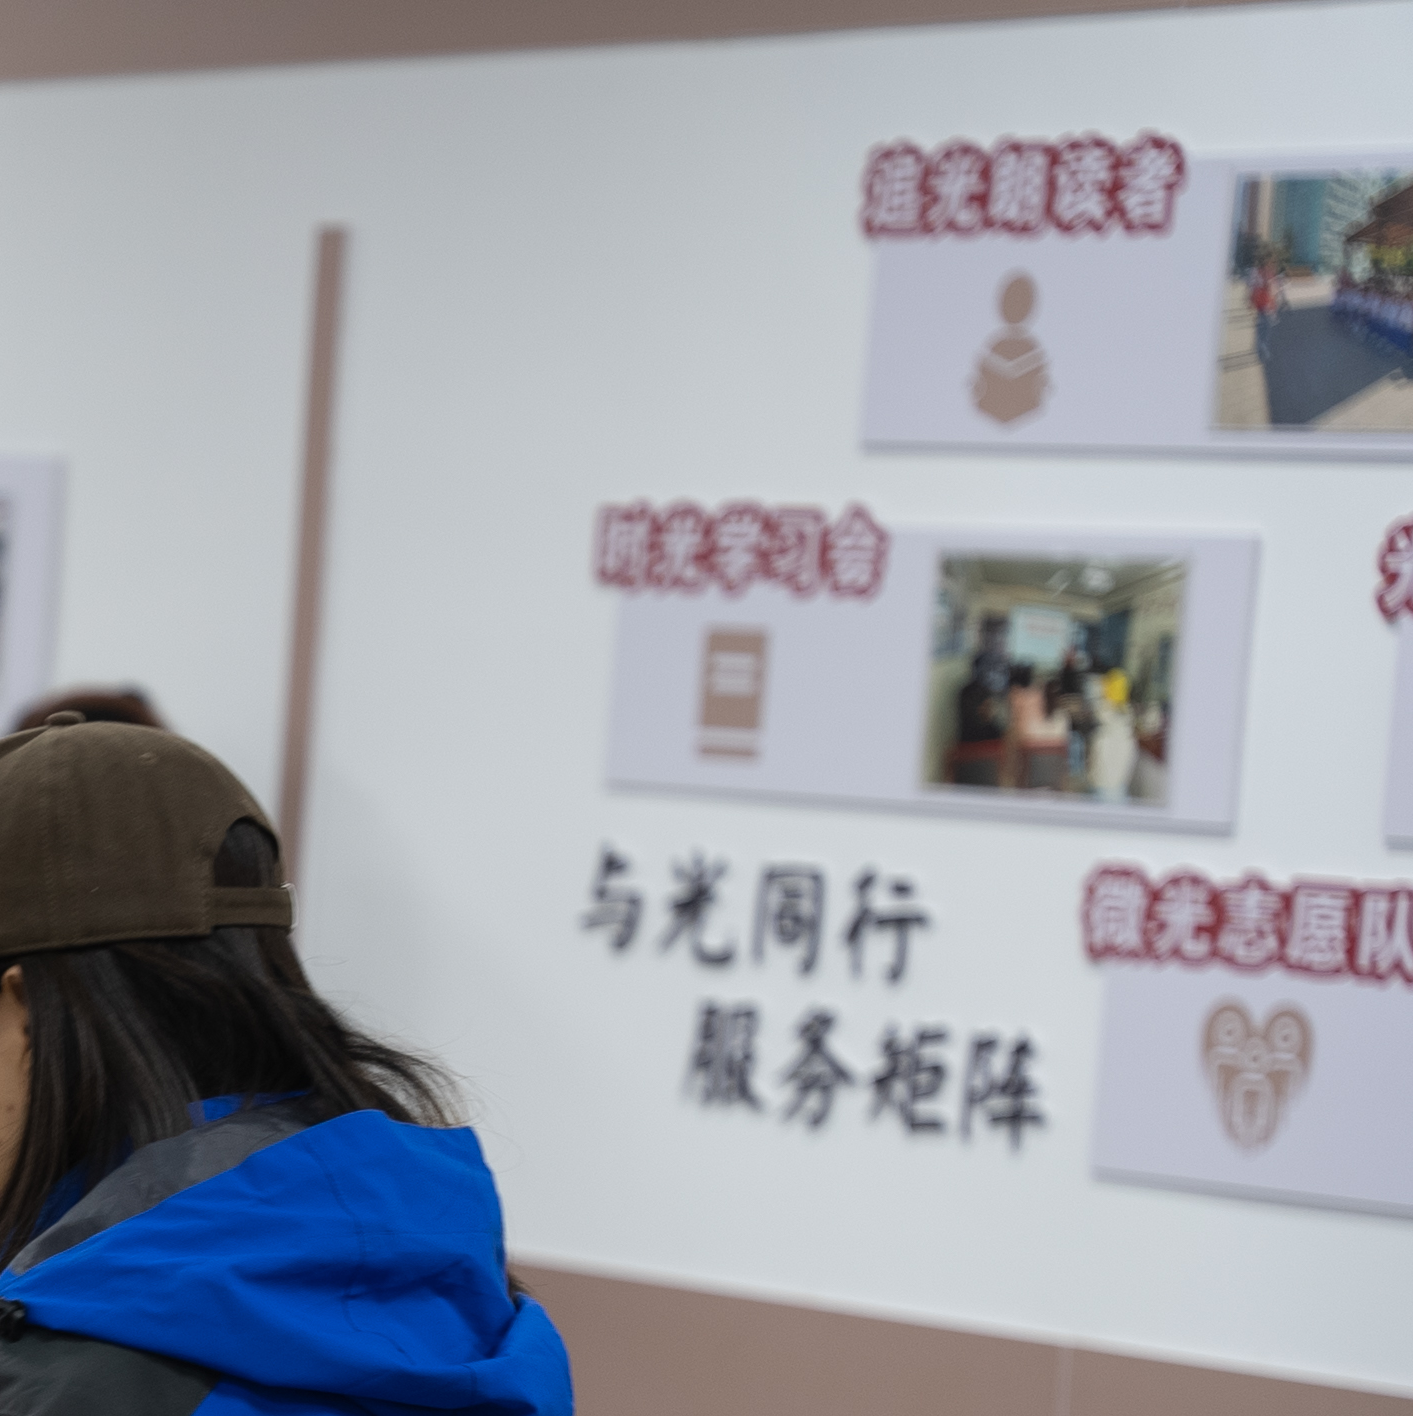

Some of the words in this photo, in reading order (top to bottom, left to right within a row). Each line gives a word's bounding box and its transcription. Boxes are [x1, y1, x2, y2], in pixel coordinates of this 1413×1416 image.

[592, 500, 891, 600] 时光学习会
[580, 843, 930, 986] 与光同行
[1080, 862, 1413, 984] 微光志愿队
[684, 998, 1049, 1153] 服务矩阵
